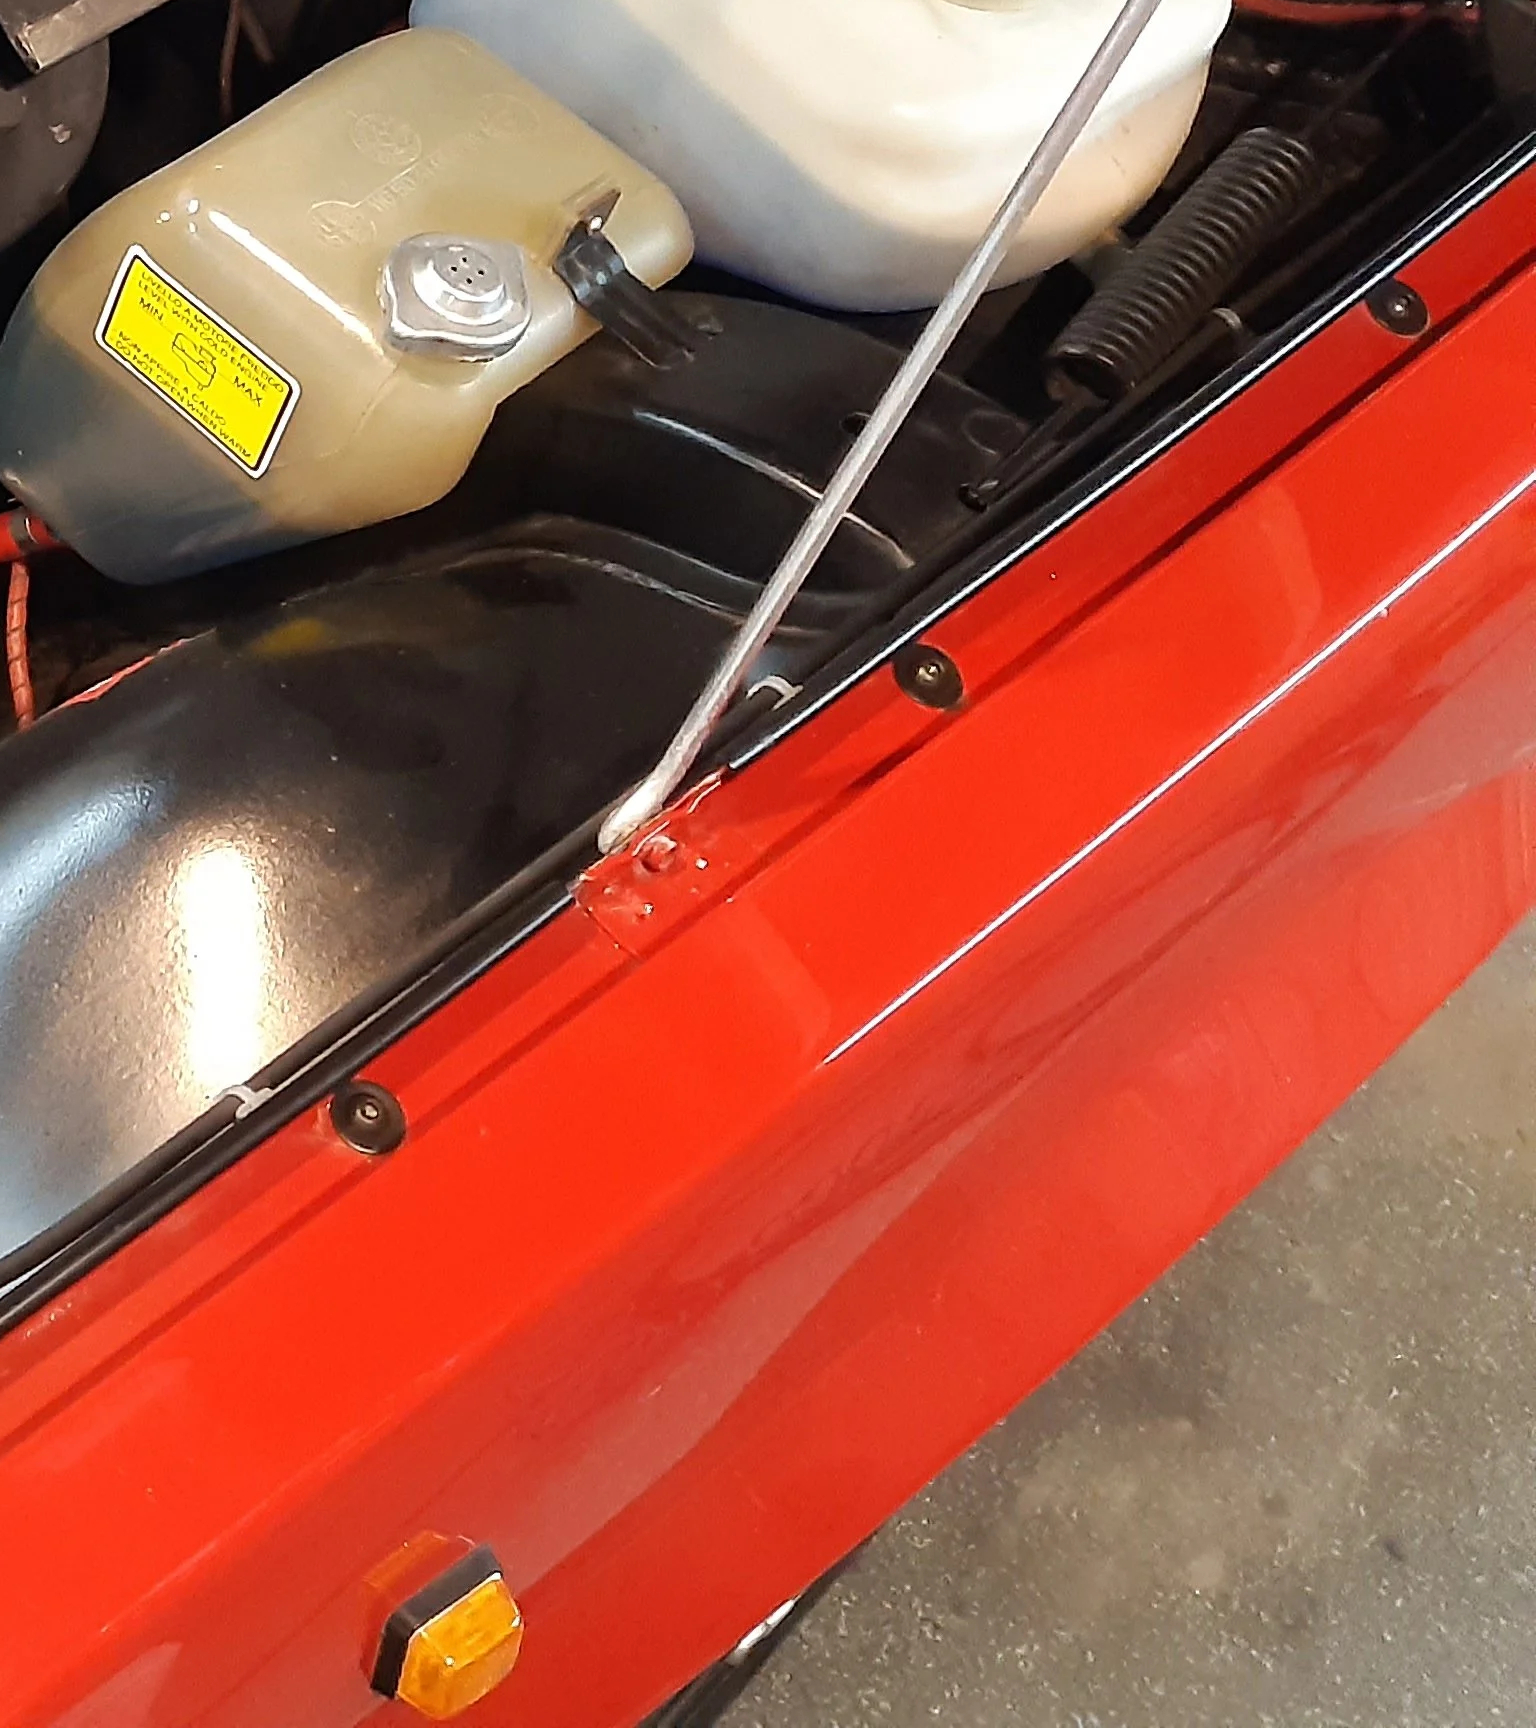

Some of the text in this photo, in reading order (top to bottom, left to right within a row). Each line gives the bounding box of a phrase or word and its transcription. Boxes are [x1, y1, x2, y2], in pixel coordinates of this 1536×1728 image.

[138, 280, 269, 392] LEVEL WITH COLD ENGINE
[139, 297, 164, 322] MIN
[141, 271, 182, 308] LIVELLO
[194, 314, 238, 353] MOTORE
[115, 340, 251, 458] DO NOT OPEN WHEN WARM
[118, 331, 141, 354] NON
[143, 353, 180, 384] APRIRE
[192, 393, 227, 426] CALDO
[233, 375, 263, 407] MAX
